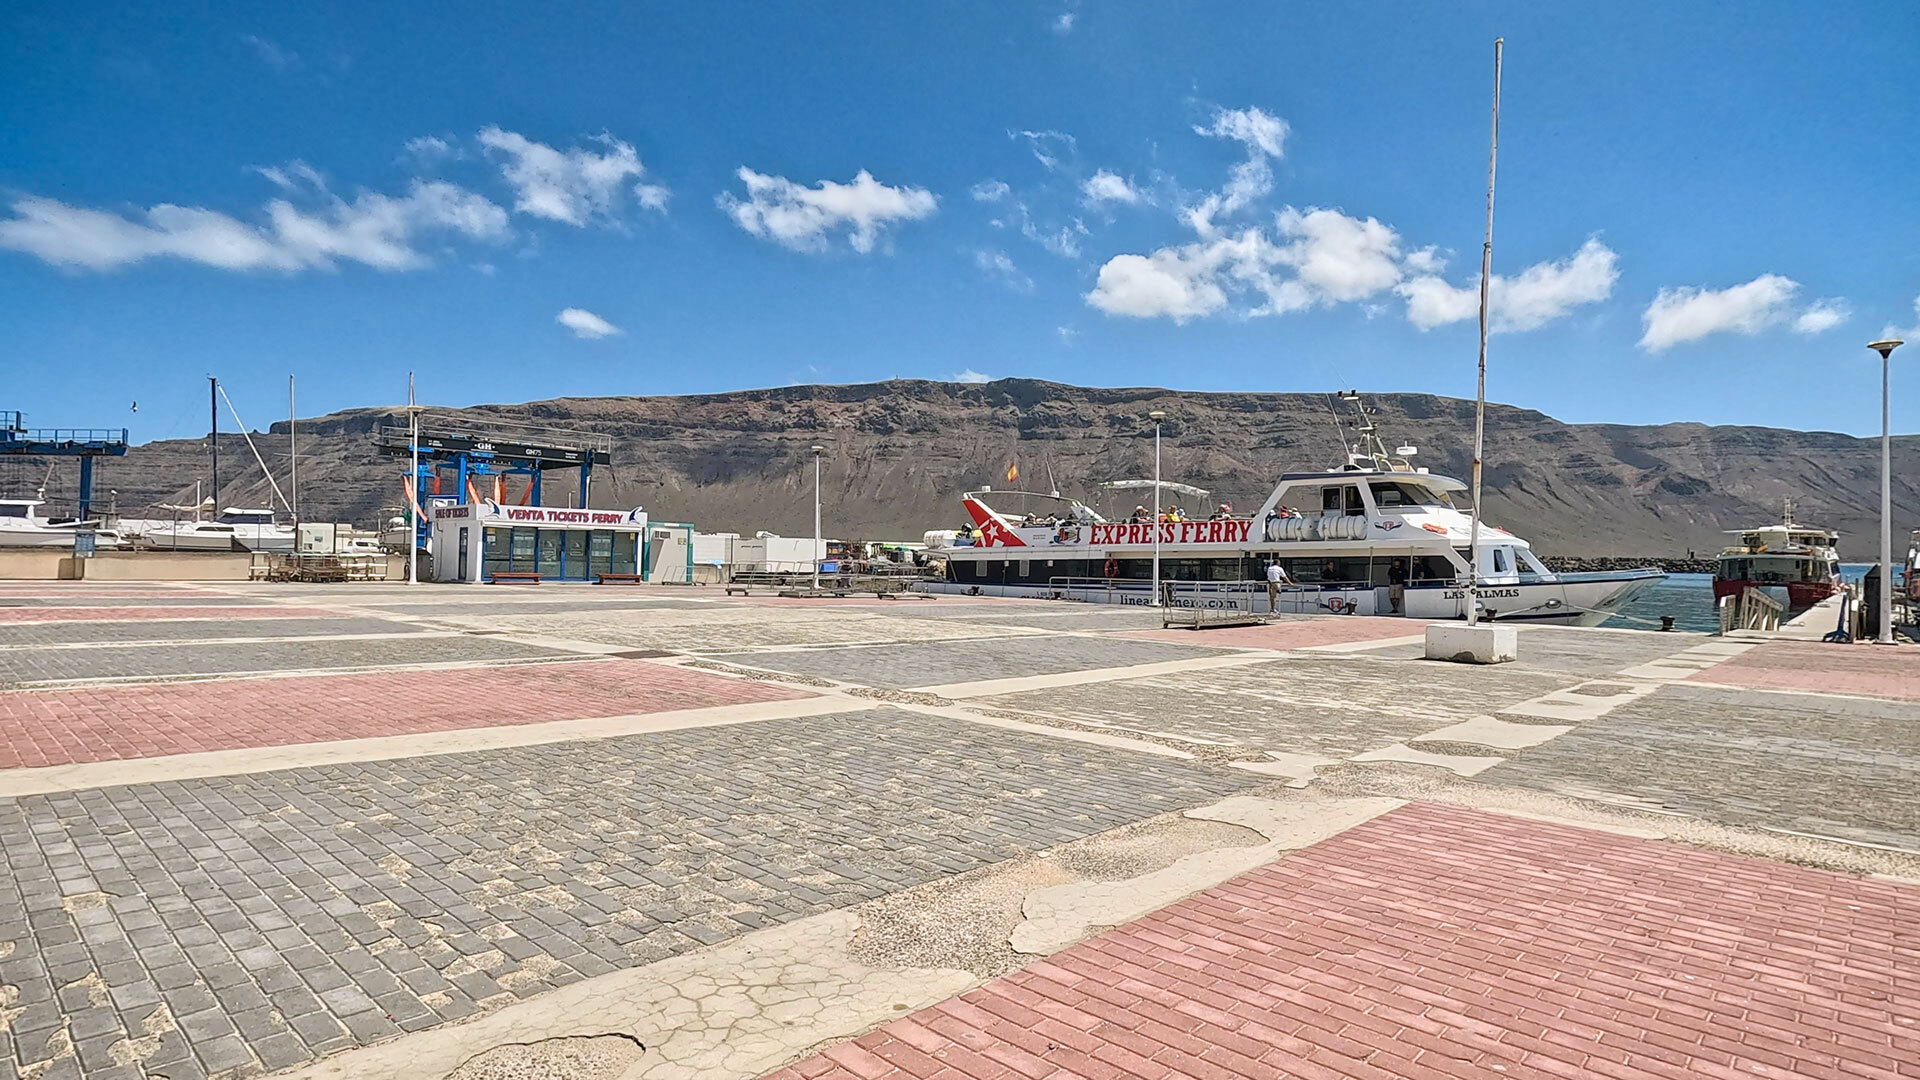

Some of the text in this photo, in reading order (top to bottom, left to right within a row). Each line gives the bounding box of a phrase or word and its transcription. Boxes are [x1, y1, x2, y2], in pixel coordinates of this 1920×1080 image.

[507, 509, 624, 524] VENTA TICKETS FERRY
[1089, 520, 1253, 544] EXPRESS FERRY
[1444, 589, 1520, 599] LAS ALMAS
